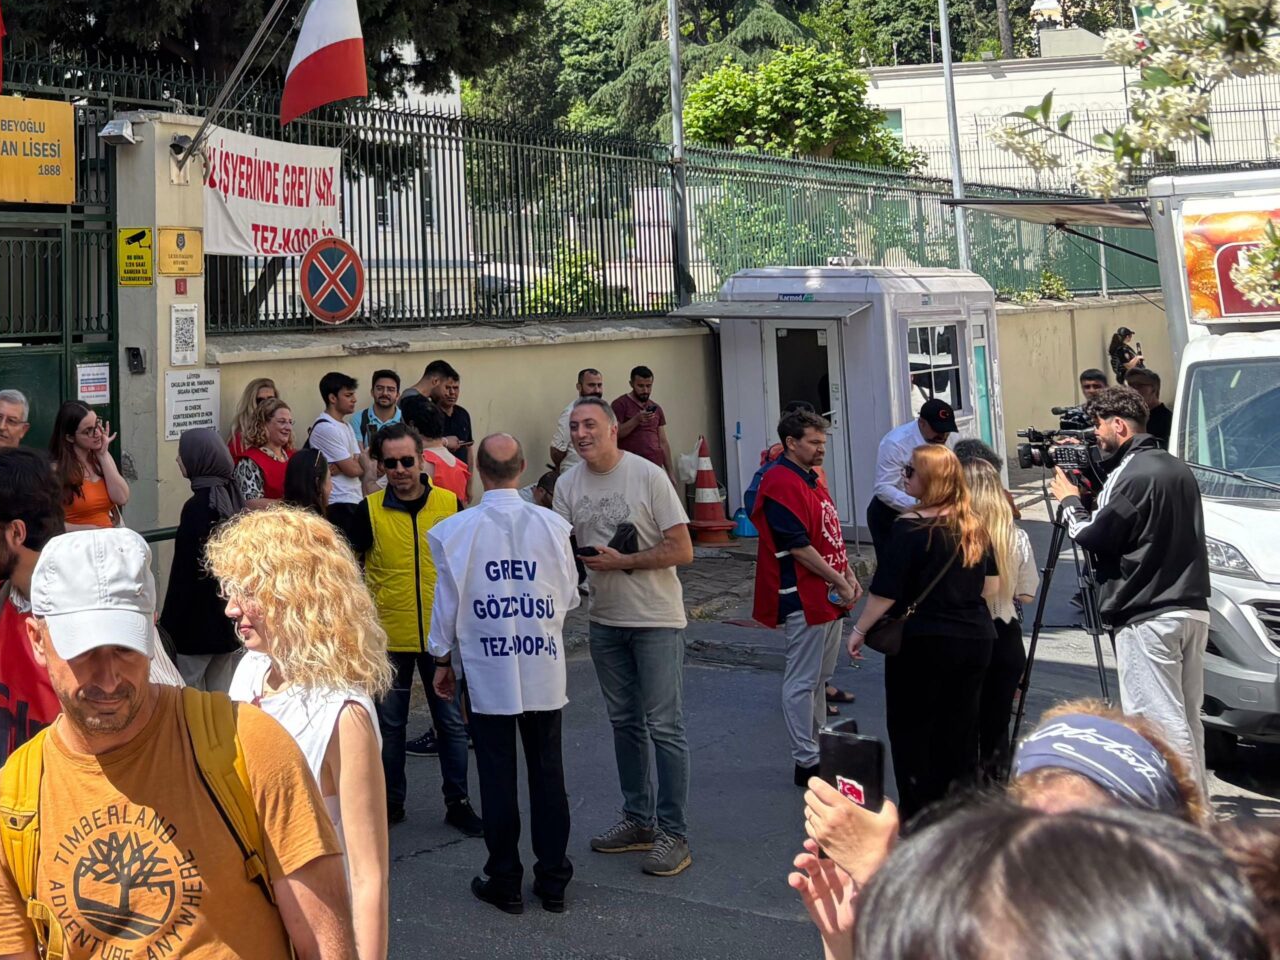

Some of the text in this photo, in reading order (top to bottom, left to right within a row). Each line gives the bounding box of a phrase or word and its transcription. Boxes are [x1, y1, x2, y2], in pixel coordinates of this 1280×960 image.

[0, 118, 46, 134] BEYOĞLU
[22, 137, 61, 159] LİSESİ
[38, 164, 61, 176] 1888
[218, 139, 280, 205] İŞYERİNDE
[282, 163, 313, 208] GREV
[485, 559, 537, 582] GREV
[473, 593, 555, 620] GÖZCÜSÜ
[54, 804, 178, 865] TIMBERLAND
[146, 849, 204, 960] ANYWHERE
[48, 879, 134, 960] ADVENTURE
